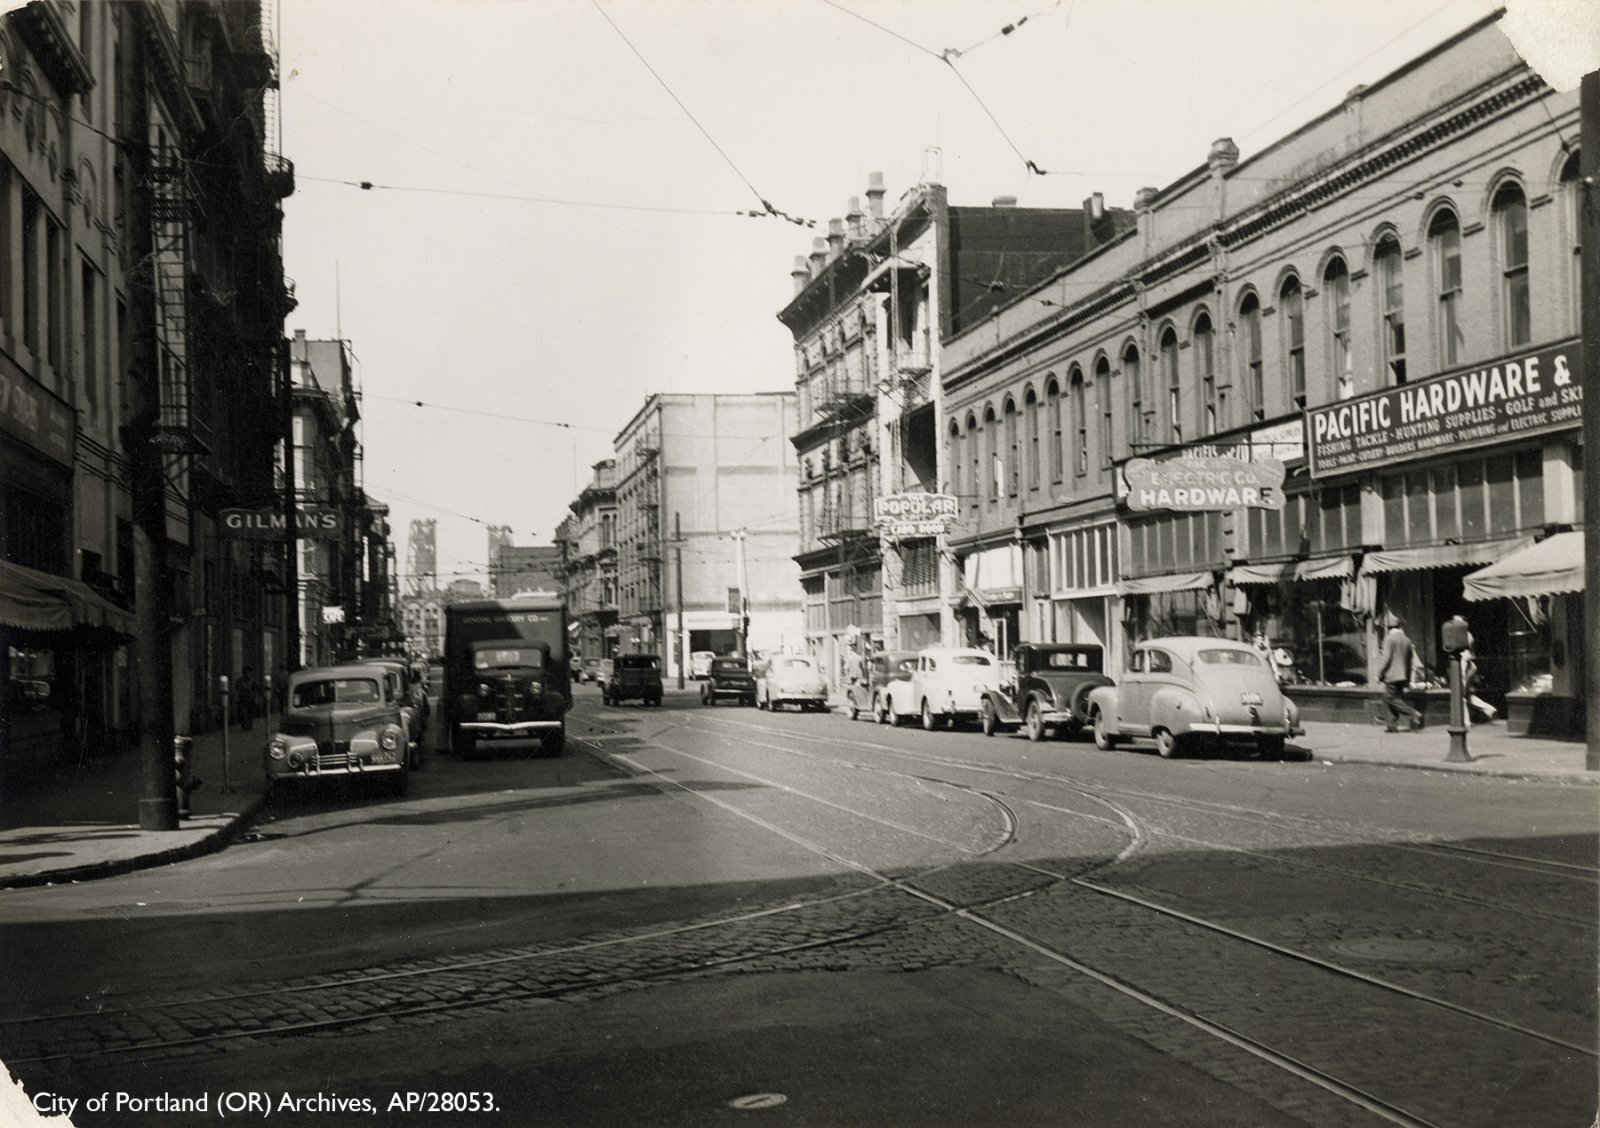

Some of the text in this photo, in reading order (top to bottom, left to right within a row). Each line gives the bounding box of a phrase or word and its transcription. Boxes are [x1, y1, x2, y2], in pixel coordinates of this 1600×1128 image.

[1315, 355, 1571, 443] PACIFIC HARDWARE &
[1317, 440, 1351, 457] FISHING
[1355, 430, 1388, 448] TACKLE
[1396, 419, 1440, 440] HUNTING
[1445, 406, 1496, 429] SUPPLIES
[1505, 397, 1535, 415] GOLF
[1538, 392, 1558, 408] and
[1458, 423, 1496, 441] PLUMBING
[1511, 412, 1547, 430] ELECTRIC
[1551, 404, 1582, 421] SUPPLI
[1140, 486, 1275, 506] HARDWARE
